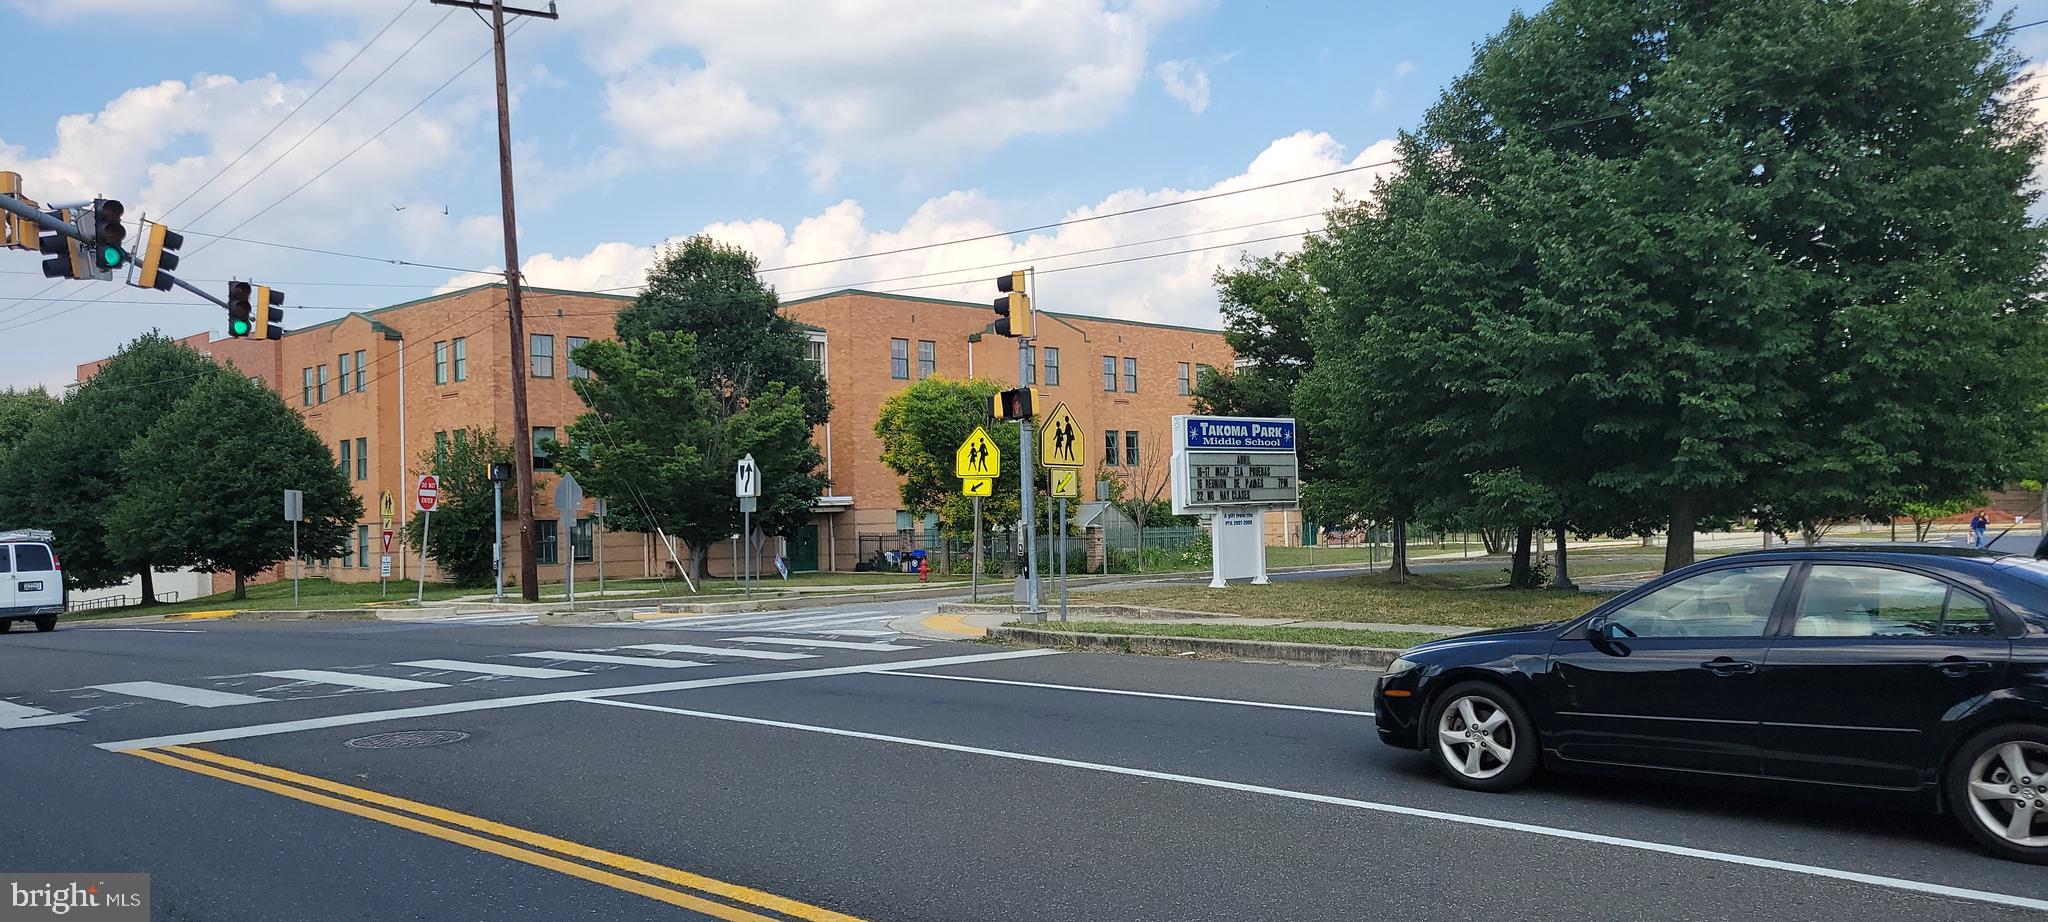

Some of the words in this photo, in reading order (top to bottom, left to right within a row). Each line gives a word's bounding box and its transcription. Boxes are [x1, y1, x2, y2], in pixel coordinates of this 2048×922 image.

[1200, 422, 1248, 436] TAKOMA
[1252, 424, 1282, 438] PARK
[1203, 437, 1242, 445] Middle
[1245, 438, 1280, 447] School
[1197, 466, 1210, 477] 16-17
[1215, 466, 1230, 477] MCAP
[1234, 466, 1243, 477] ELA
[1249, 466, 1270, 477] PRUEBAS
[1205, 478, 1226, 488] REUNION
[1234, 478, 1240, 488] DE
[1278, 477, 1288, 488] 7PM
[1197, 490, 1203, 501] 22
[1207, 490, 1214, 500] NO
[1220, 490, 1229, 500] HAY
[1232, 490, 1250, 500] CLASES
